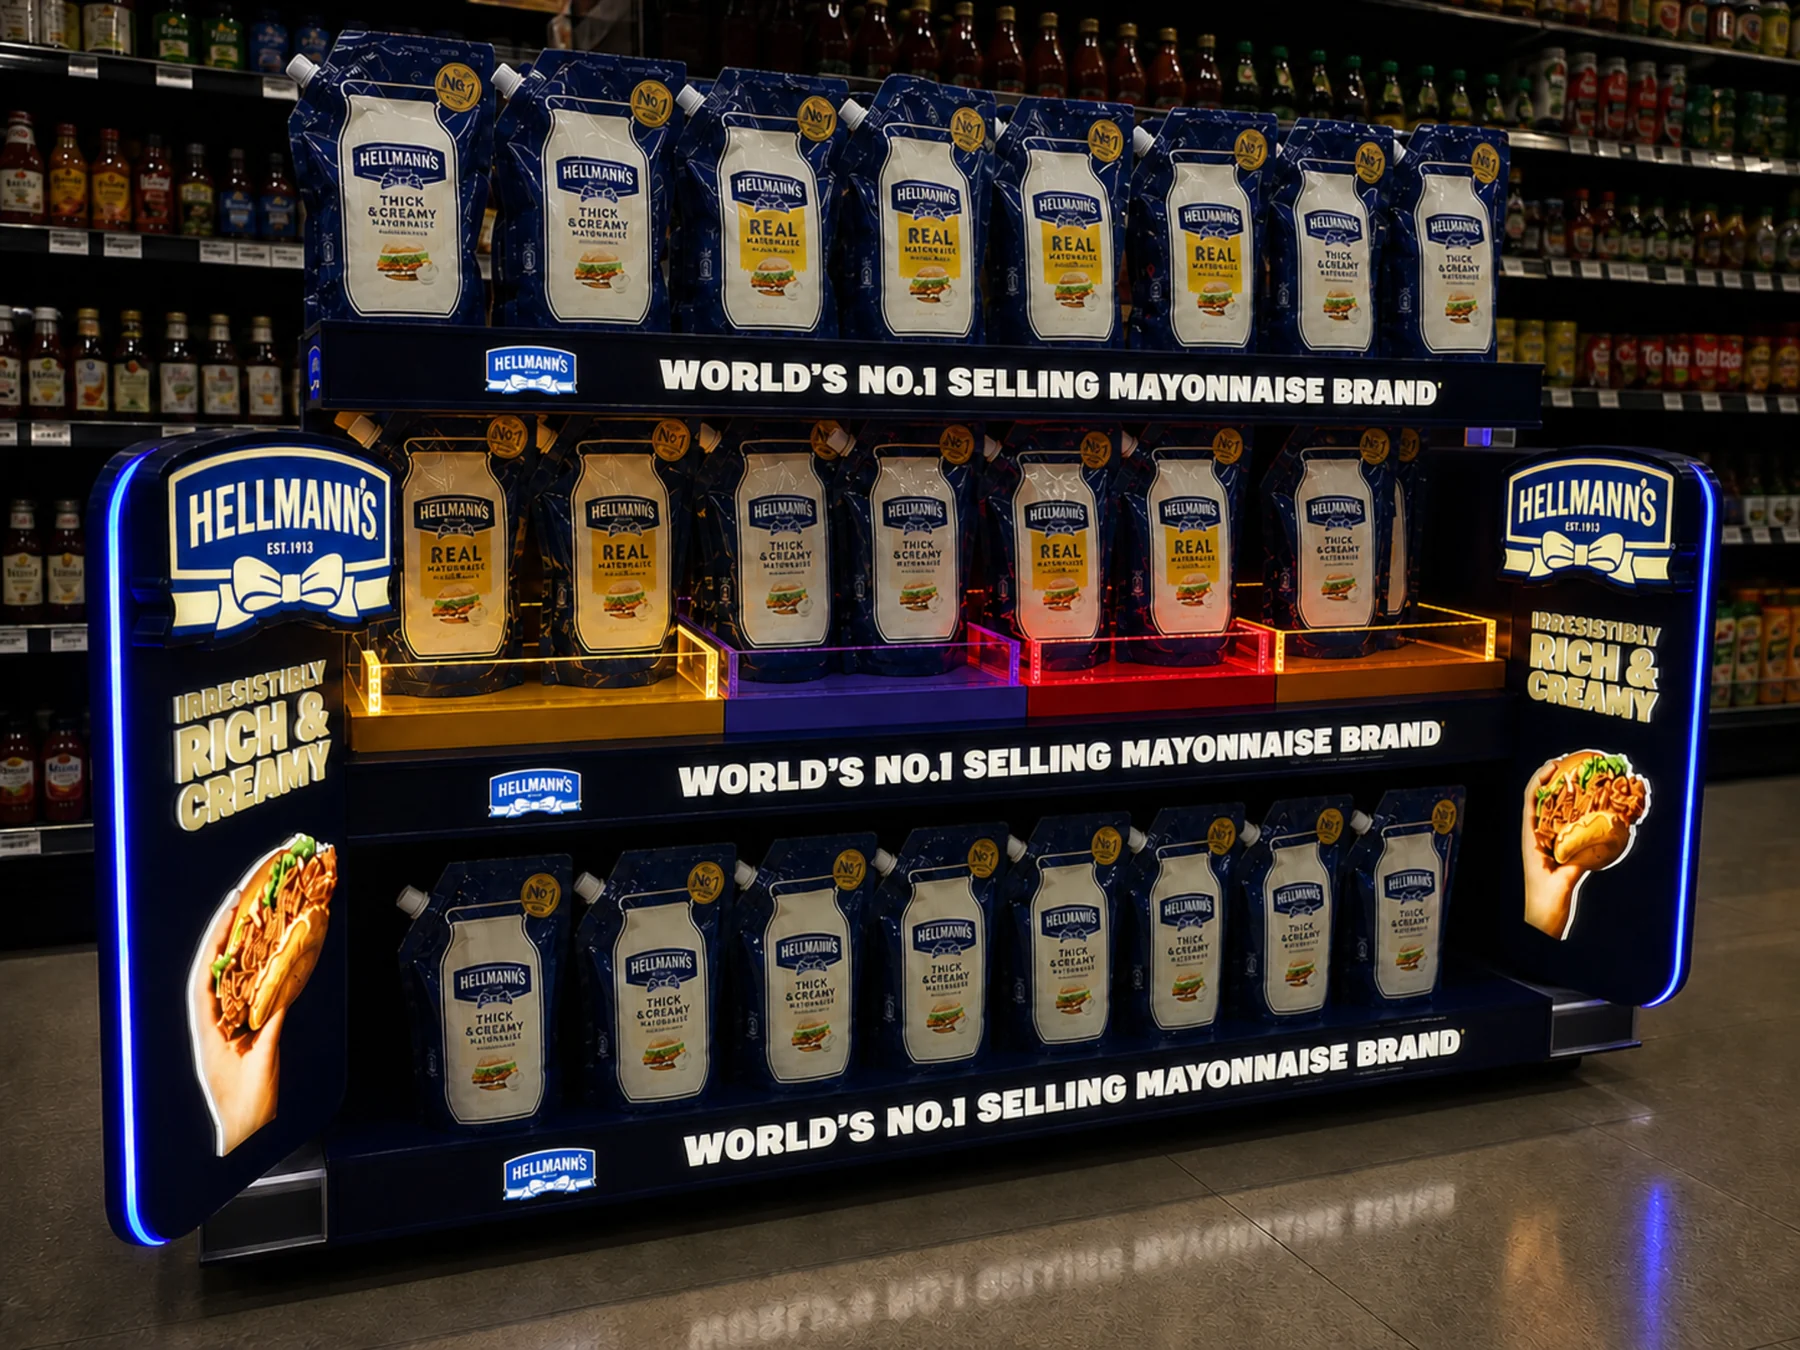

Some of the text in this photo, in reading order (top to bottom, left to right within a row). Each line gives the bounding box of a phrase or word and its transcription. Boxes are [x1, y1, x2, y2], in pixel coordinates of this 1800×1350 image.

[360, 151, 439, 170] HELLMANN'S
[563, 165, 633, 185] HELLMANN'S
[737, 177, 802, 198] HELLMANN'S
[897, 187, 956, 205] HELLMANN'S
[380, 196, 424, 207] THICK
[1040, 198, 1097, 214] HELLMANN'S
[579, 207, 617, 218] THICK
[1185, 209, 1240, 226] HELLMANN'S
[750, 220, 797, 237] REAL
[908, 228, 952, 245] REAL
[1052, 236, 1095, 252] REAL
[1196, 246, 1235, 262] REAL
[495, 355, 568, 374] HELLMANN'S
[660, 360, 847, 394] WORLD'S
[859, 364, 936, 396] NO.1
[947, 367, 1099, 400] SELLING
[1109, 371, 1324, 404] MAYONNAISE
[420, 501, 489, 520] HELLMANN'S
[592, 501, 654, 520] HELLMANN'S
[754, 500, 813, 518] HELLMANN'S
[888, 501, 944, 518] HELLMANN'S
[1165, 502, 1217, 517] HELLMANN'S
[1518, 477, 1657, 527] HELLMANN'S
[189, 477, 378, 549] HELLMANN'S
[1030, 506, 1085, 521] HELLMANN'S
[1565, 521, 1600, 533] EST.1913
[267, 541, 314, 556] EST.1913
[603, 544, 648, 560] REAL
[770, 541, 803, 550] THICK
[903, 540, 933, 549] THICK
[1041, 544, 1081, 558] REAL
[1175, 540, 1212, 554] REAL
[431, 545, 482, 563] REAL
[1531, 610, 1662, 648] IRRESISTIBLY
[1529, 632, 1659, 690] RICH &
[172, 659, 327, 724] IRRESISTIBLY
[1527, 670, 1660, 724] CREAMY
[173, 690, 331, 784] RICH &
[679, 757, 864, 797] WORLD'S
[876, 751, 953, 786] NO.1
[963, 741, 1112, 780] SELLING
[1122, 727, 1333, 769] MAYONNAISE
[175, 739, 332, 832] CREAMY
[497, 776, 570, 798] HELLMANN'S
[1046, 909, 1097, 928] HELLMANN'S
[918, 923, 972, 942] HELLMANN'S
[781, 938, 838, 959] HELLMANN'S
[1059, 947, 1087, 957] THICK
[631, 952, 692, 975] HELLMANN'S
[932, 962, 961, 974] THICK
[460, 968, 525, 990] HELLMANN'S
[796, 978, 827, 990] THICK
[647, 995, 680, 1008] THICK
[476, 1011, 513, 1024] THICK
[683, 1111, 875, 1168] WORLD'S
[887, 1097, 966, 1138] NO.1
[977, 1074, 1127, 1123] SELLING
[1136, 1043, 1349, 1100] MAYONNAISE
[512, 1153, 586, 1181] HELLMANN'S
